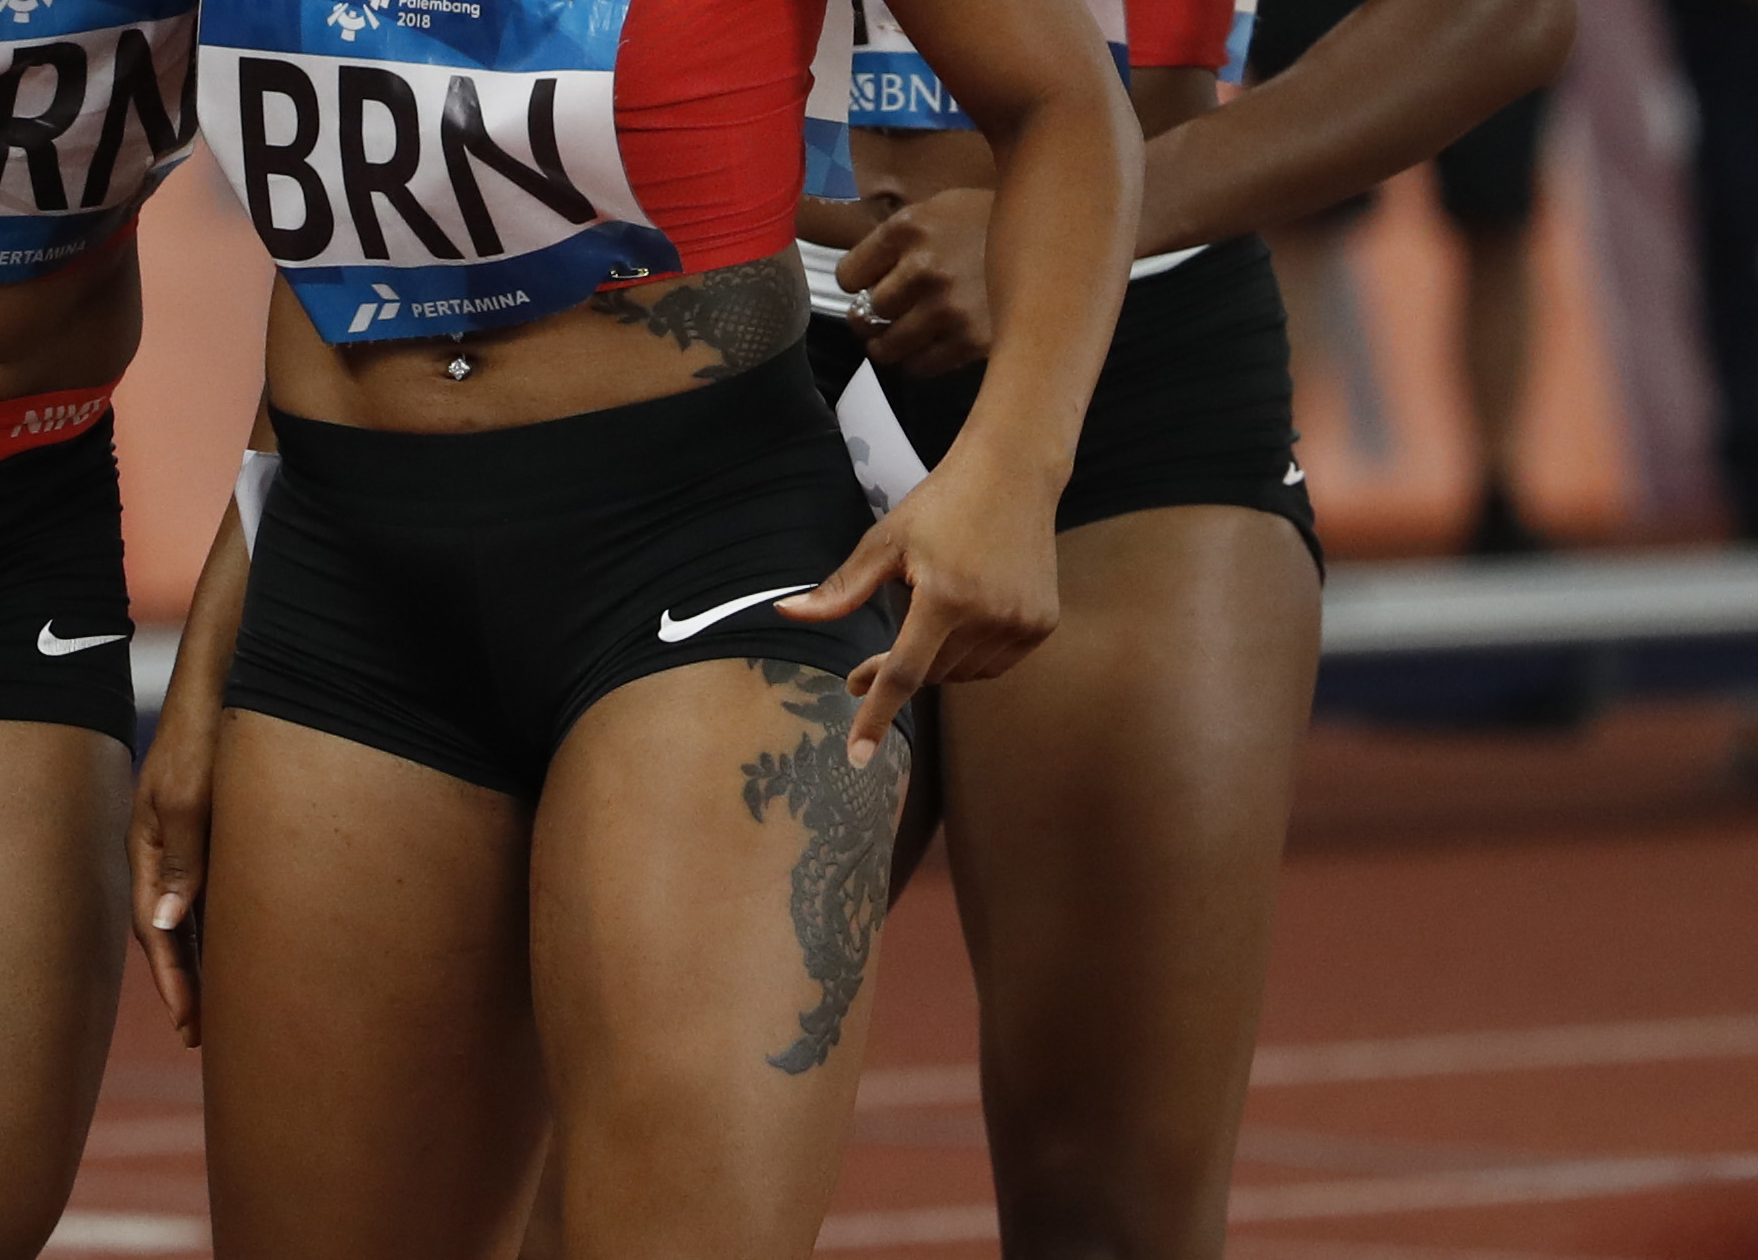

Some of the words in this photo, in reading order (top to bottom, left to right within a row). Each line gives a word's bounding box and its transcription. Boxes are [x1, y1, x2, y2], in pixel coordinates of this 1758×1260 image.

[397, 11, 431, 28] 2018
[239, 56, 598, 261] BRN
[411, 290, 531, 318] PERTAMINA
